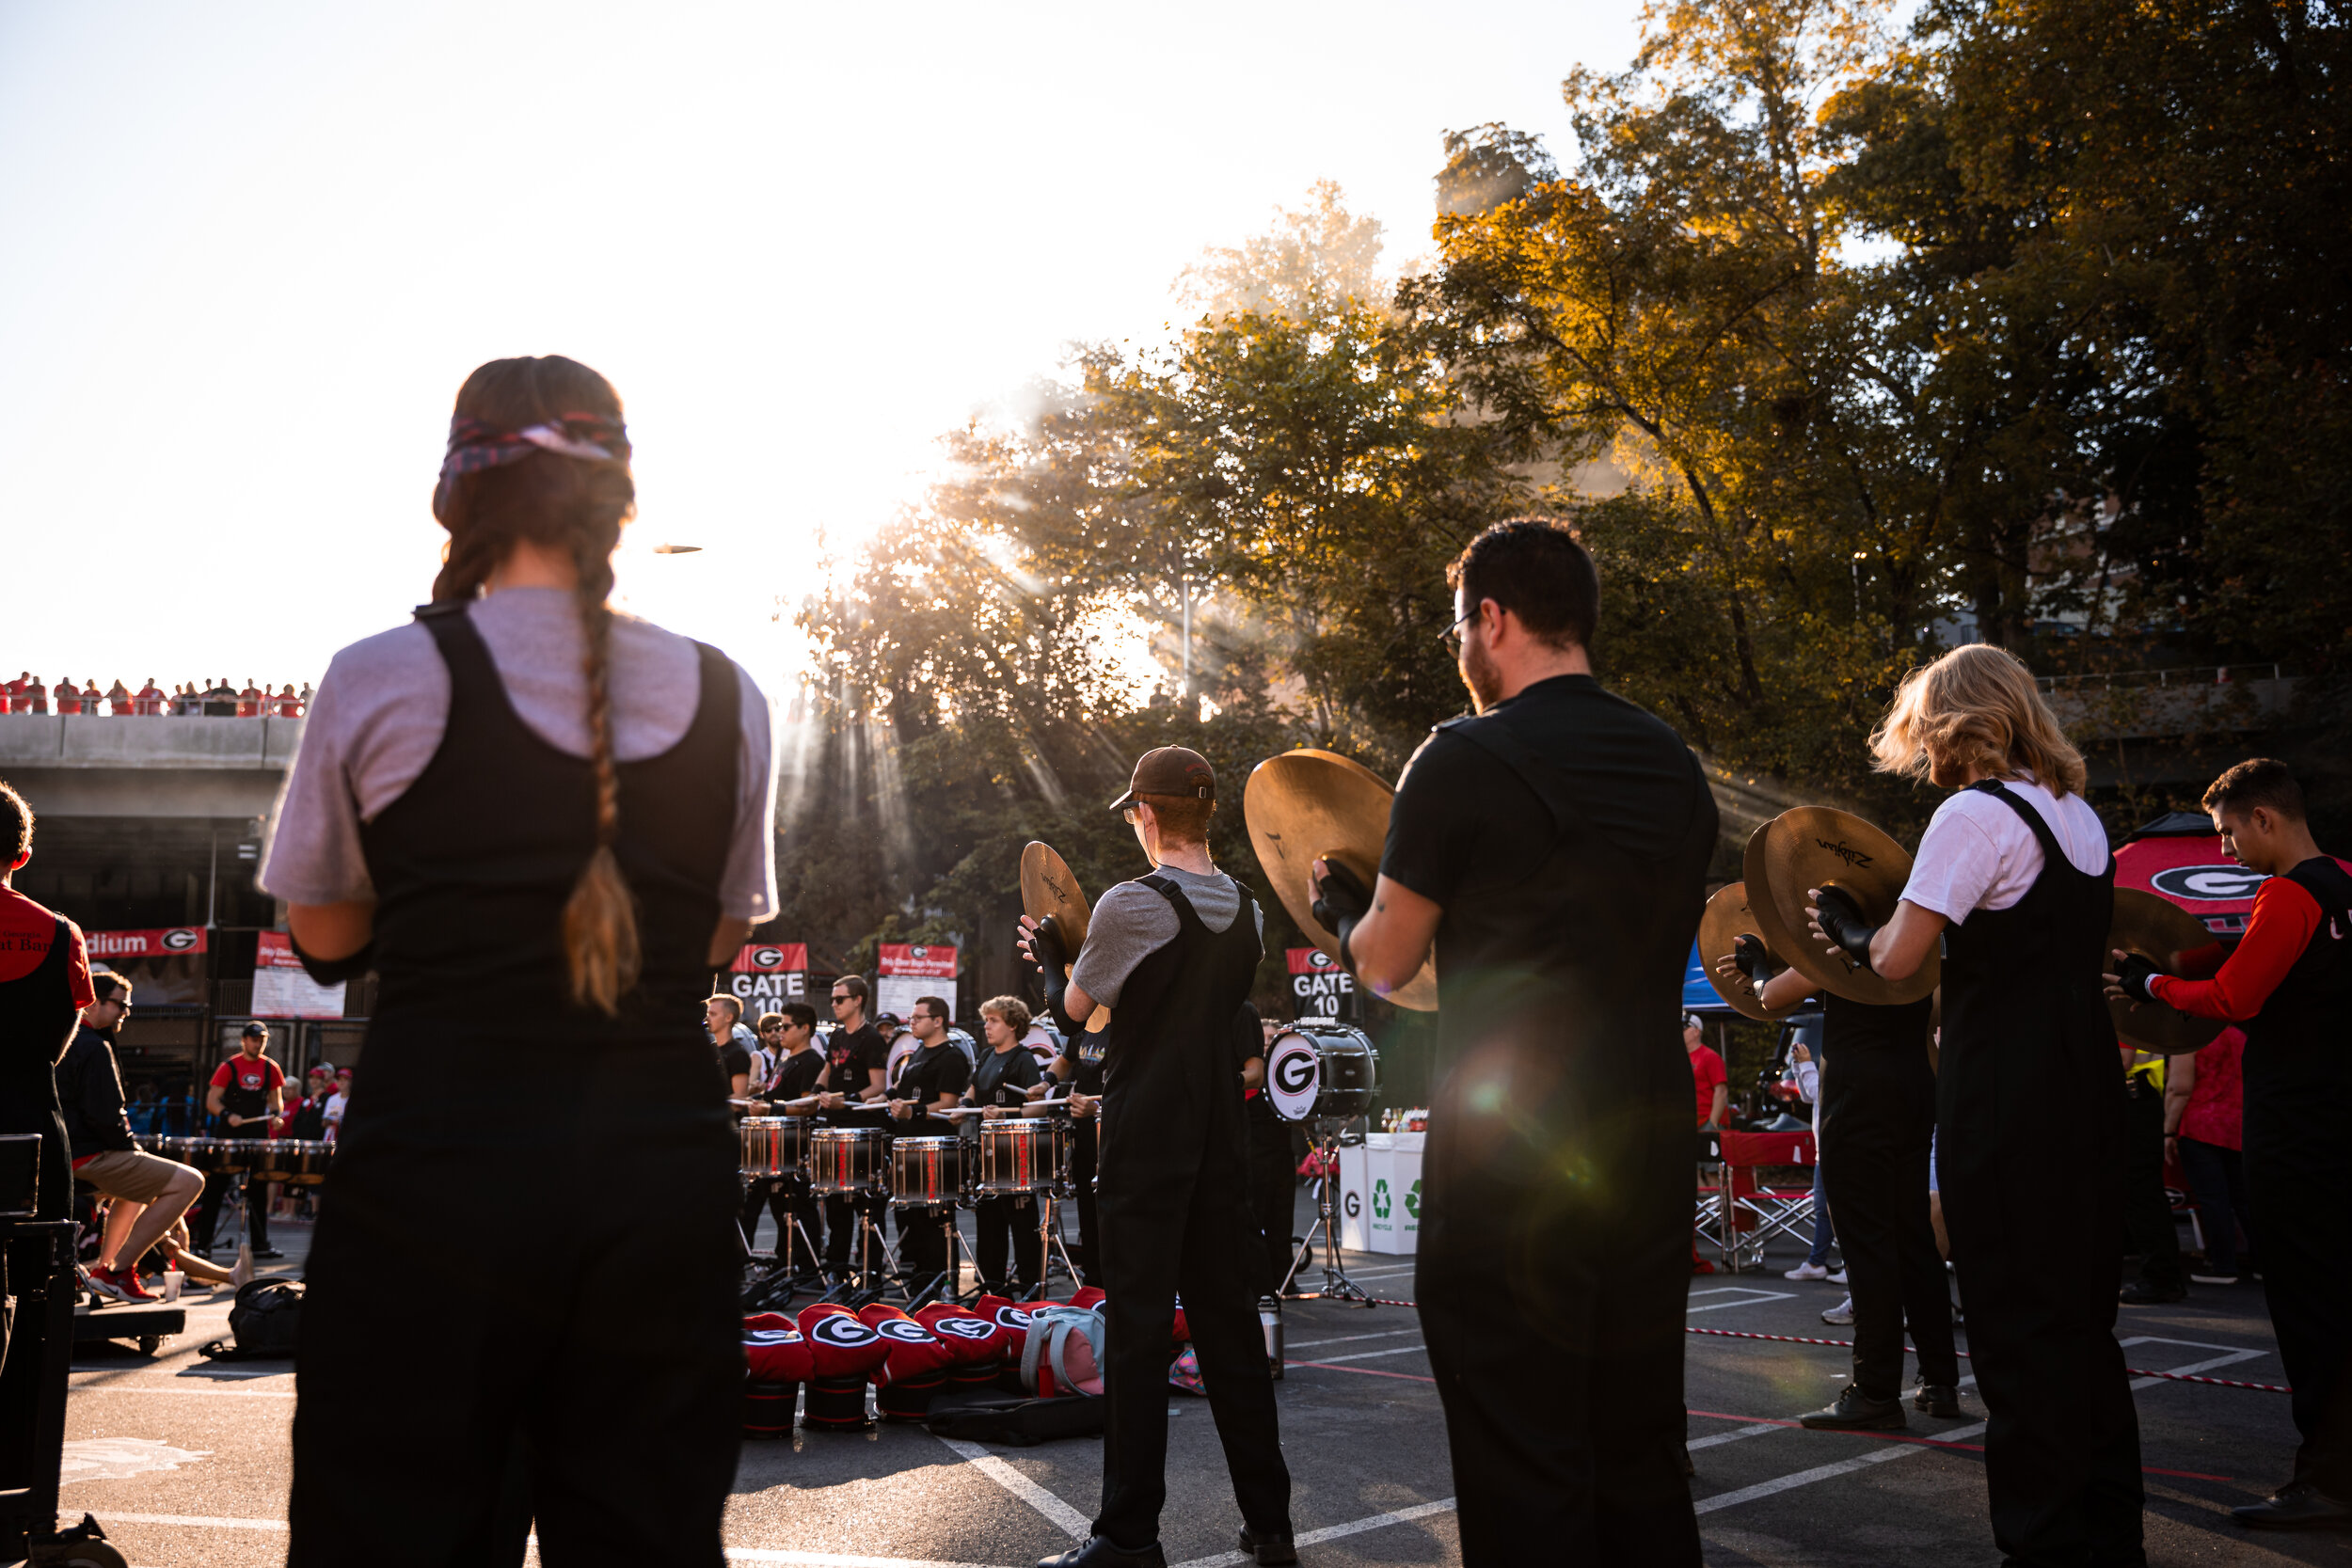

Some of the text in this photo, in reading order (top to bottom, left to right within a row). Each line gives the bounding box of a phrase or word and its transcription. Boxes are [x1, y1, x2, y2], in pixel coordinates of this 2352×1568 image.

[1816, 838, 1874, 868] Zildjian
[3, 930, 41, 939] Georgia
[87, 934, 148, 954] dium
[732, 973, 804, 997] GATE
[1294, 973, 1354, 997] GATE
[755, 997, 784, 1016] 10
[1313, 995, 1340, 1016] 10
[1275, 1051, 1316, 1094] G
[1019, 1134, 1028, 1187] GEORGIA
[1344, 1190, 1361, 1218] G
